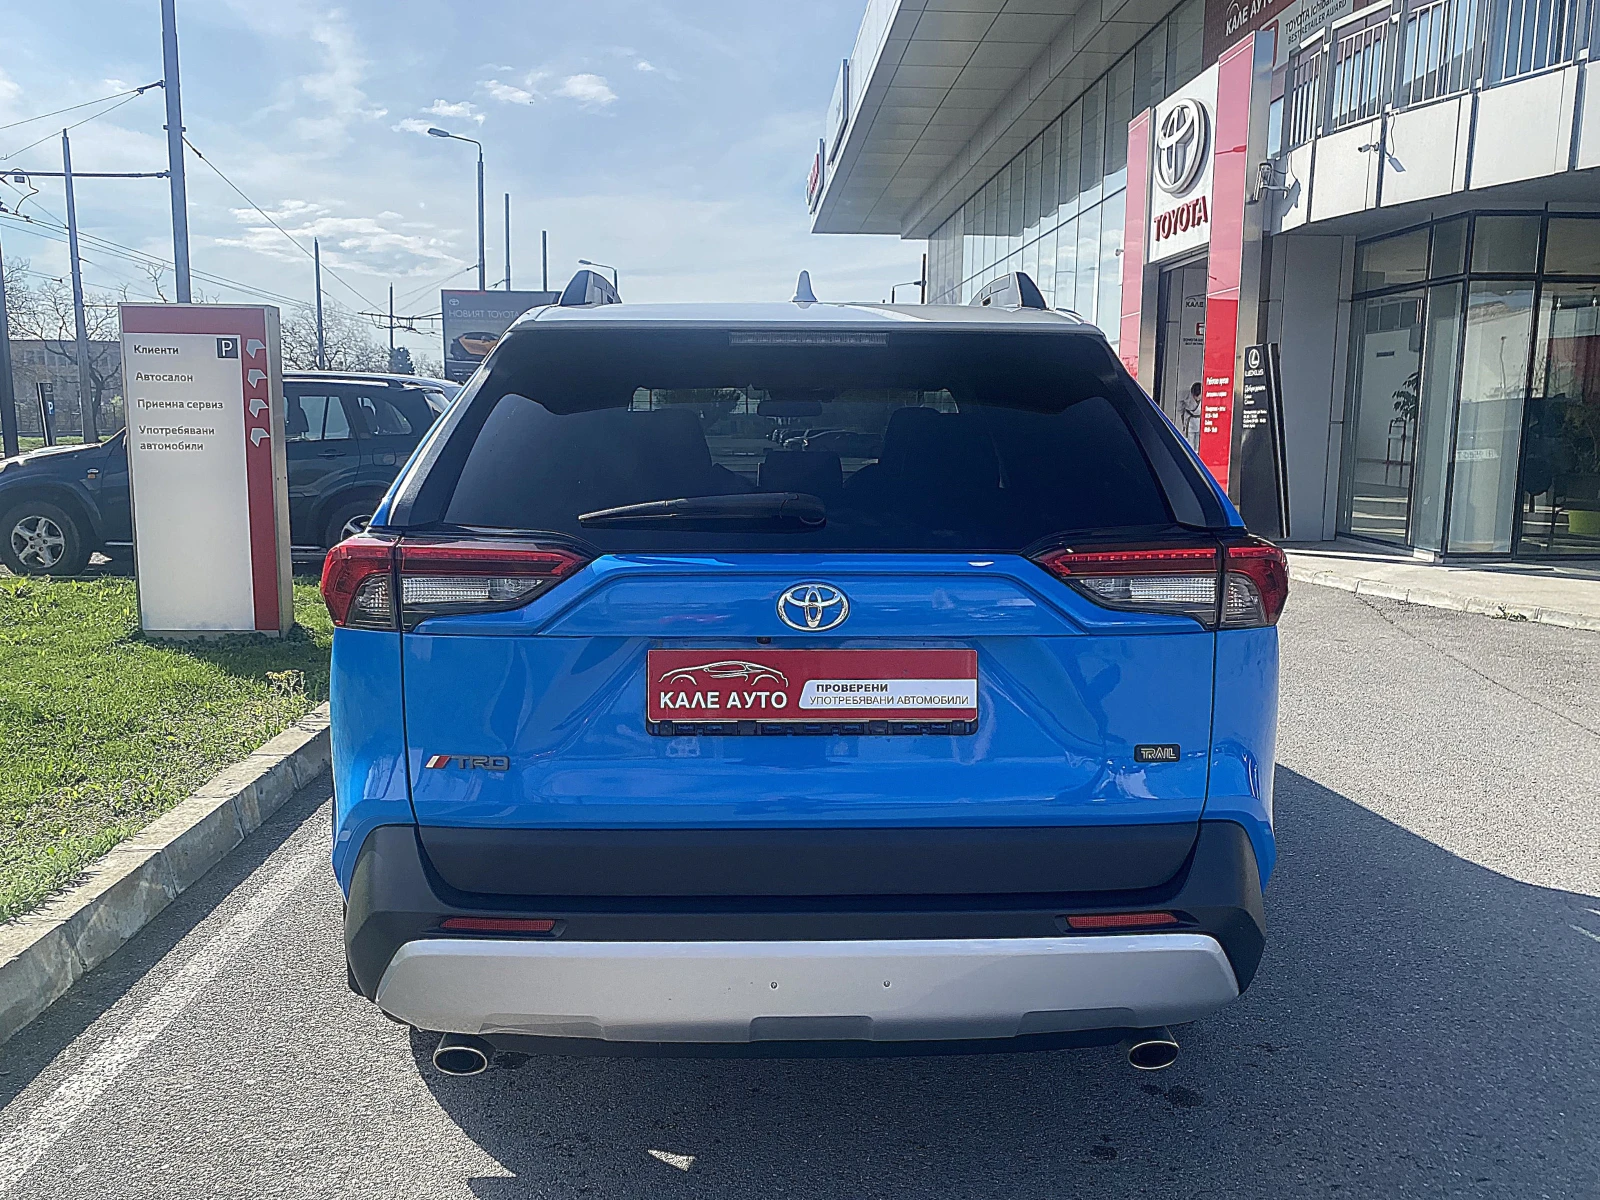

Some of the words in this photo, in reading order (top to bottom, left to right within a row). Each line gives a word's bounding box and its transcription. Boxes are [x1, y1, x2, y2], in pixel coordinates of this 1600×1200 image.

[1225, 5, 1248, 37] КАЛЕ
[1285, 8, 1310, 35] TOYOTA
[1287, 29, 1300, 45] BEST
[1301, 13, 1326, 34] RETAILER
[1154, 195, 1208, 242] TOYOTA
[448, 309, 484, 318] НОВИЯТ
[487, 310, 519, 319] TOYOTA
[133, 344, 179, 355] Клиенти
[221, 340, 233, 357] P
[135, 372, 194, 382] Автосалон
[1244, 368, 1264, 377] LEXUS
[137, 399, 185, 410] Приемна
[186, 401, 224, 411] сервиз
[138, 425, 215, 437] Употребявани
[139, 441, 204, 451] автомобили
[815, 682, 889, 693] ПРОВЕРЕНИ
[659, 691, 721, 710] КАЛЕ
[726, 691, 788, 710] АУТО
[809, 695, 895, 706] УПОТРЕБЯВАНИ
[896, 695, 969, 706] АВТОМОБИЛИ
[1140, 746, 1177, 760] TRAIL
[450, 755, 510, 771] TRD
